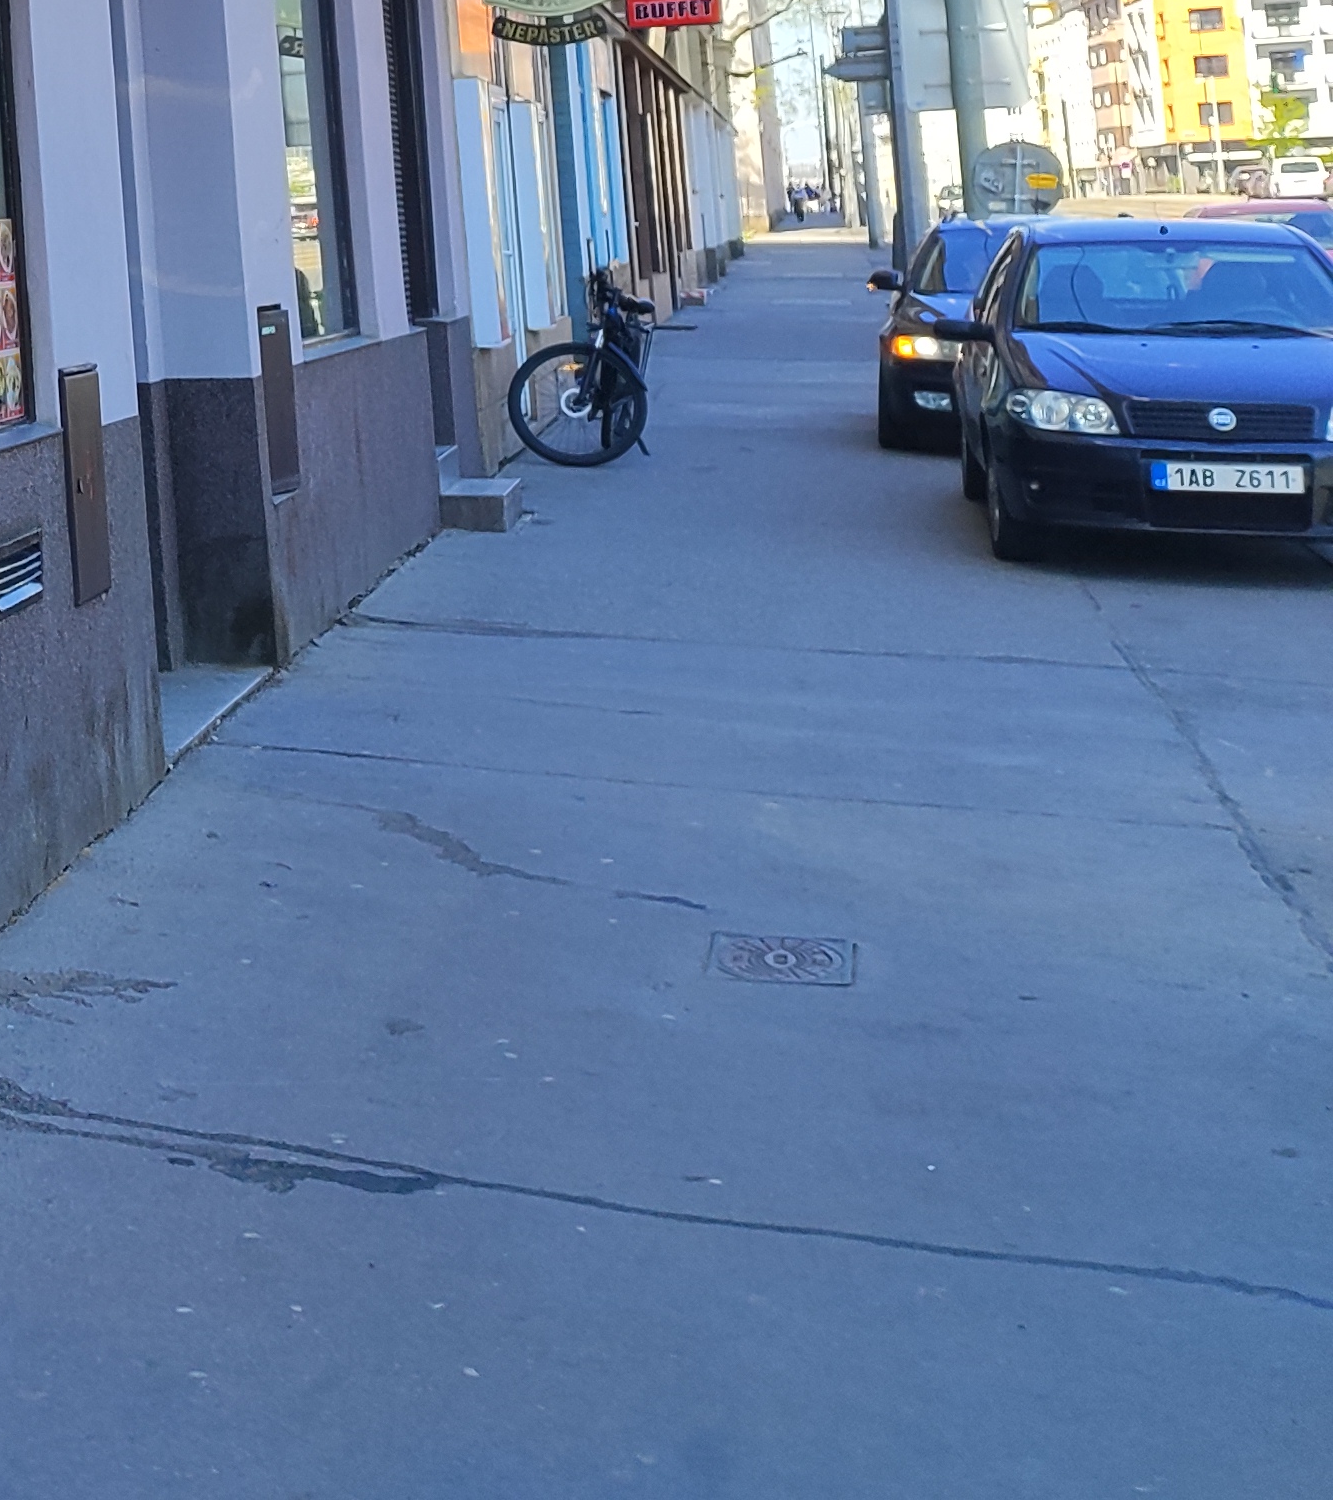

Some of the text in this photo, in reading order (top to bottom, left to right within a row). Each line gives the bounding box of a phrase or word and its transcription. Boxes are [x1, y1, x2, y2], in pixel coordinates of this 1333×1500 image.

[635, 0, 712, 20] BUFFET
[503, 15, 603, 43] NEPASTER
[1175, 468, 1290, 488] 1AB Z611
